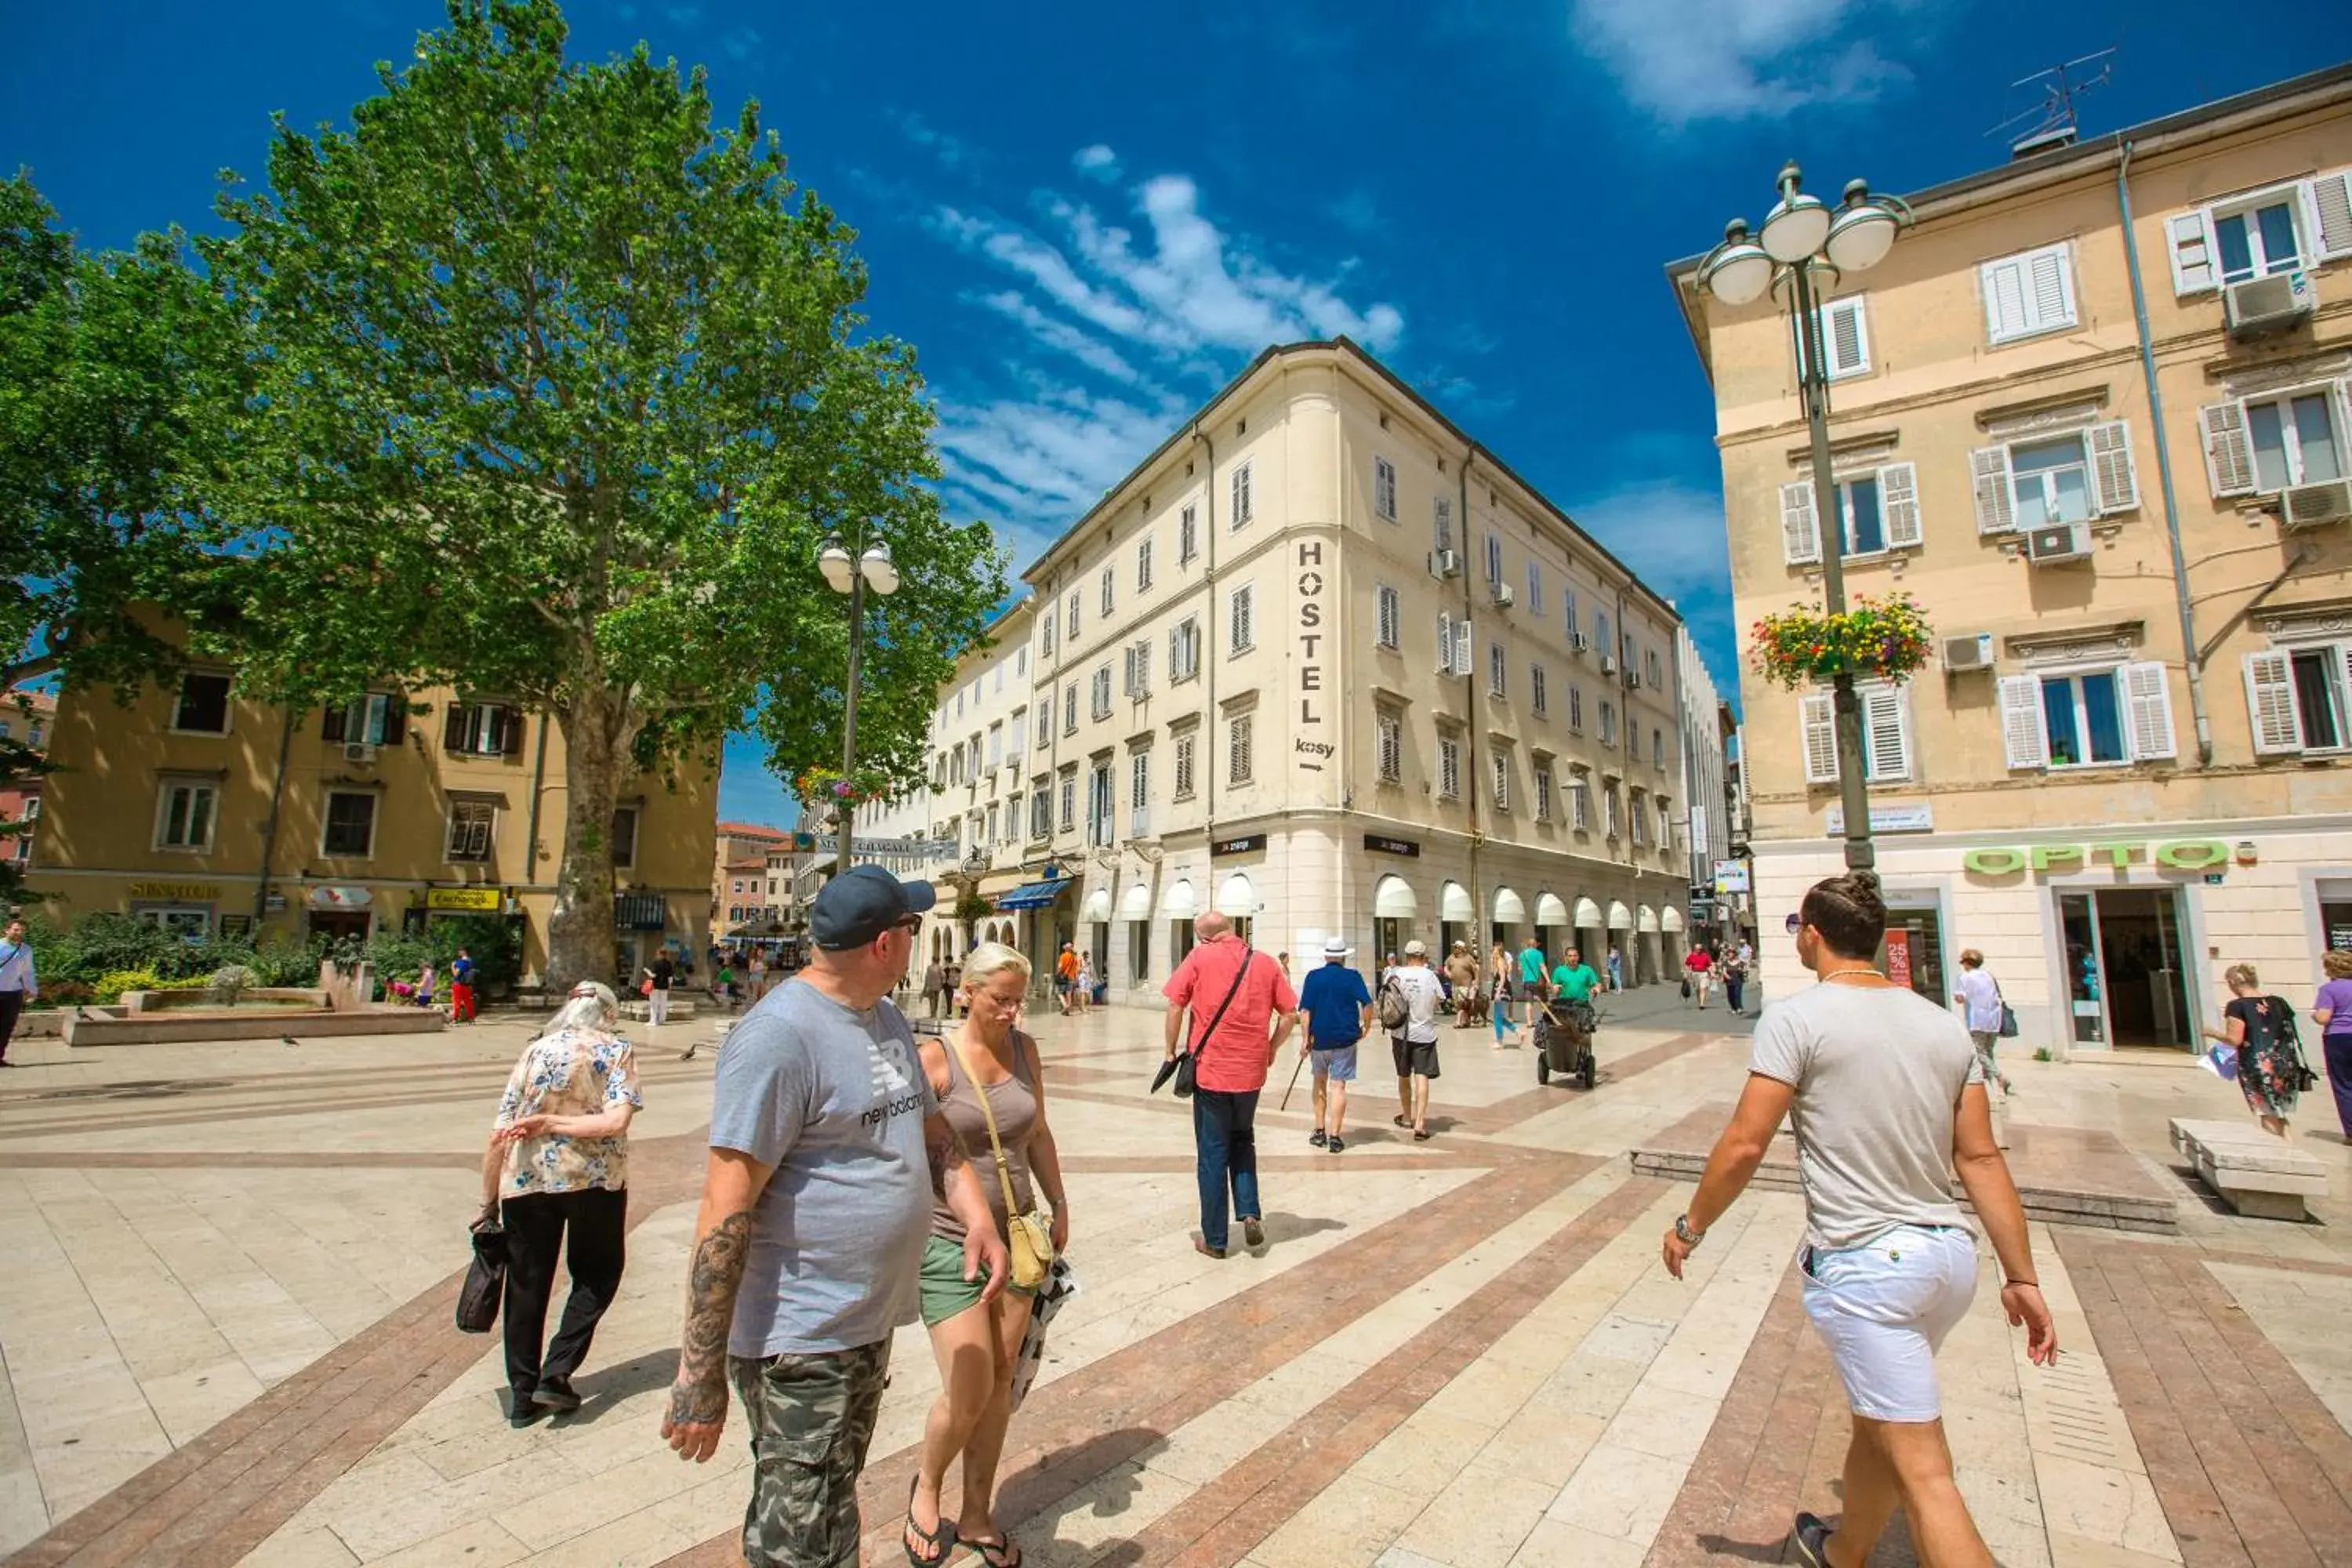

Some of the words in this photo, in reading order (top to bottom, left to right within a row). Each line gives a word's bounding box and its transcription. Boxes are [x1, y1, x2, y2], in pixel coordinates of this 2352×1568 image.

[1298, 542, 1323, 724] HOSTEL
[1294, 738, 1335, 760] kosy
[1964, 840, 2230, 875] OPTO
[1888, 943, 1907, 956] 25
